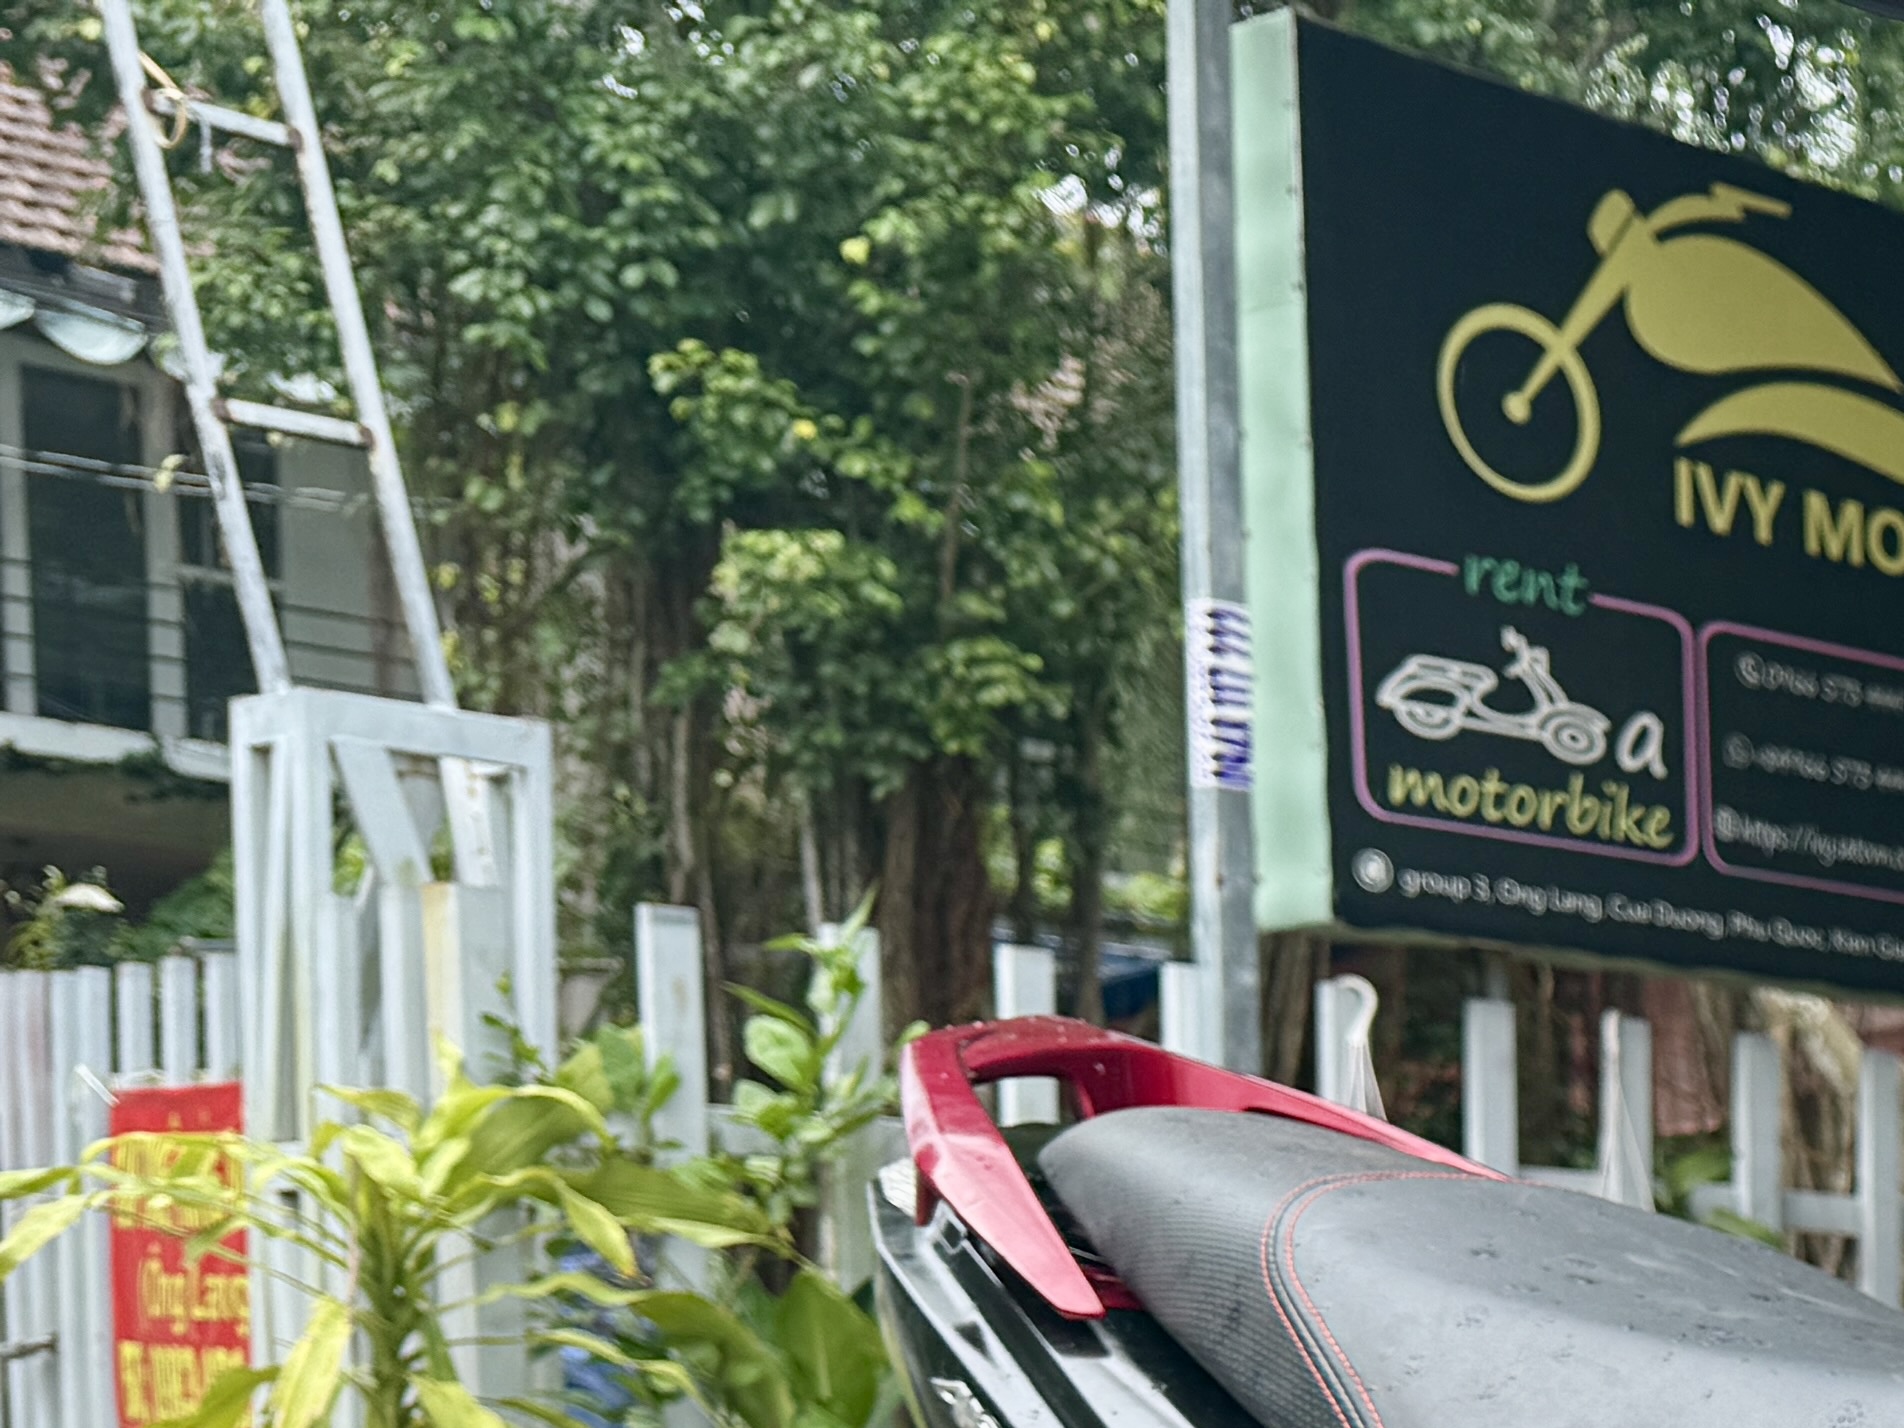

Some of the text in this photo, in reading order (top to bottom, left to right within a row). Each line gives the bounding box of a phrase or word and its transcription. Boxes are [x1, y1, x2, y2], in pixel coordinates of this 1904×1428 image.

[1674, 457, 1785, 546] IVY
[1463, 554, 1590, 617] rent
[1614, 710, 1668, 780] a
[1387, 765, 1674, 848] motorbike
[1398, 868, 1471, 904] group
